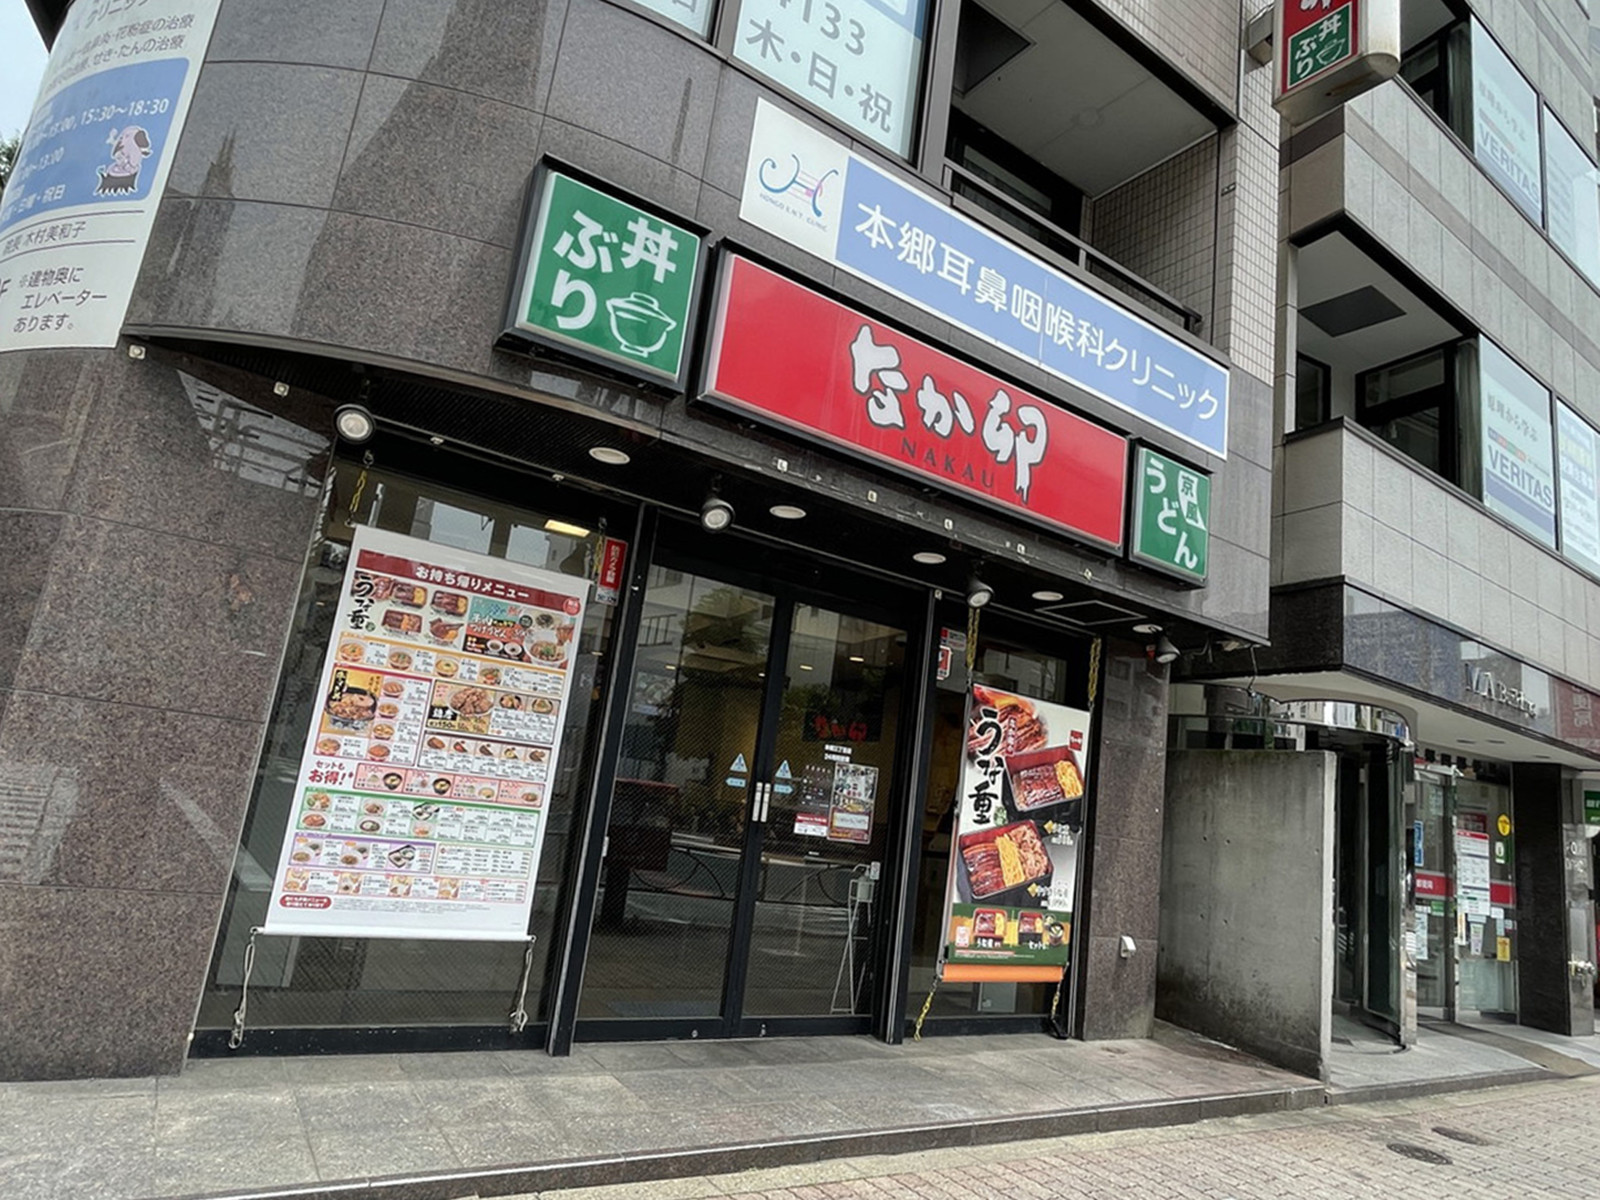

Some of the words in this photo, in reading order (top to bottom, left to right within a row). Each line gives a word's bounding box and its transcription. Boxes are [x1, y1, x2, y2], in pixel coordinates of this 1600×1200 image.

[745, 18, 892, 133] 木・日・祝
[1479, 122, 1540, 204] VERITAS
[551, 209, 619, 330] ぶり
[621, 216, 679, 284] 丼
[14, 313, 74, 333] あります。
[21, 289, 107, 309] エレベーター
[855, 201, 1219, 421] 本郷耳鼻咽喉科クリニック
[850, 324, 1048, 504] なか卯
[901, 437, 995, 489] NAKAU
[1487, 445, 1552, 508] VERITAS
[1146, 457, 1198, 569] うどん
[346, 575, 375, 630] うな重
[415, 566, 529, 599] お持ち帰りメニュー
[968, 708, 1004, 825] うな重
